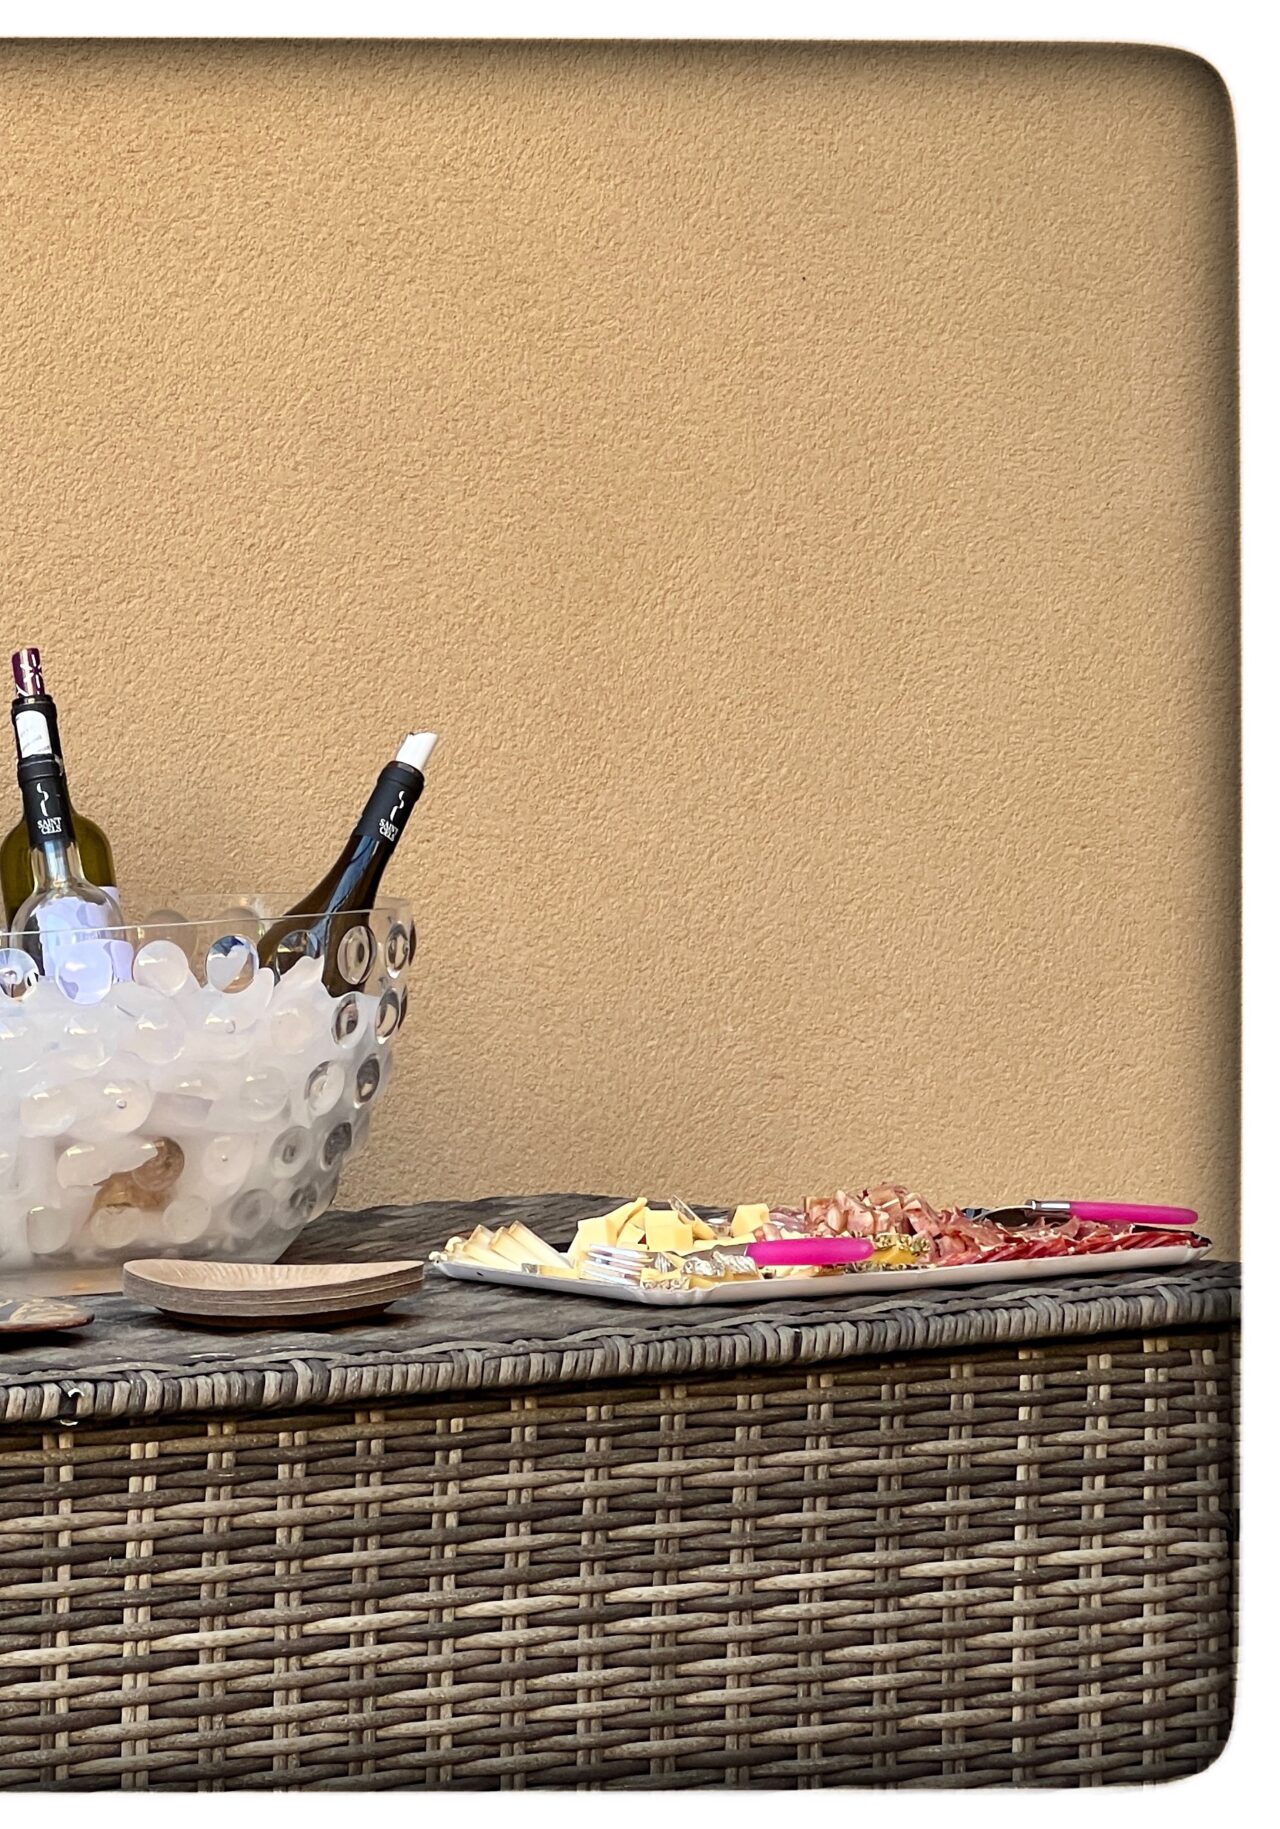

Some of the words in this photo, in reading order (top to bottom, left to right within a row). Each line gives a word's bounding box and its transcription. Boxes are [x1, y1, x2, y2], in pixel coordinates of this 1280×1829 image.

[37, 816, 61, 829] SAINT
[41, 824, 62, 834] CELS
[379, 818, 399, 835] SAINT
